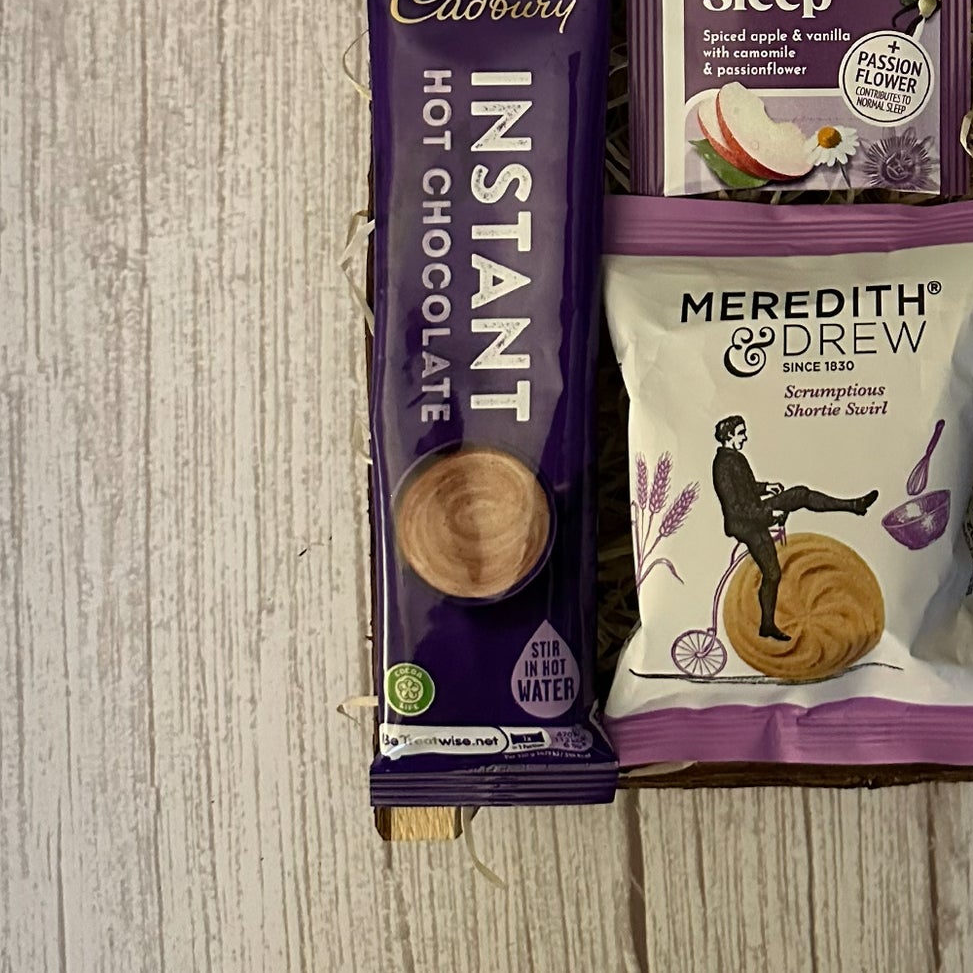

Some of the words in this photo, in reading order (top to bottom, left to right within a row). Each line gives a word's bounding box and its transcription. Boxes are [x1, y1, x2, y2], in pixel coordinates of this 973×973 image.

[703, 29, 746, 44] Spiced
[750, 30, 788, 44] apple
[792, 30, 803, 42] &
[806, 29, 851, 42] vanilla
[703, 46, 730, 59] with
[733, 46, 796, 59] camomile
[703, 63, 713, 76] &
[716, 62, 807, 78] passionflower
[857, 51, 923, 77] PASSION
[855, 68, 917, 94] FLOWER
[855, 86, 901, 103] CONTRIBUTES
[902, 94, 912, 106] TO
[423, 70, 452, 151] HOT
[856, 97, 885, 111] NORMAL
[886, 103, 906, 115] SLEEP
[470, 71, 533, 422] INSTANT
[421, 168, 452, 423] CHOCOLATE
[724, 326, 775, 378] &
[783, 321, 927, 356] DREW
[782, 361, 821, 373] SINCE
[824, 360, 855, 372] 1830
[784, 382, 886, 401] Scrumptious
[784, 402, 841, 418] Shortie
[845, 401, 888, 416] Swirl
[531, 640, 560, 658] STIR
[394, 667, 423, 679] COCOA
[525, 660, 538, 677] IN
[543, 659, 566, 677] HOT
[517, 677, 574, 702] WATER
